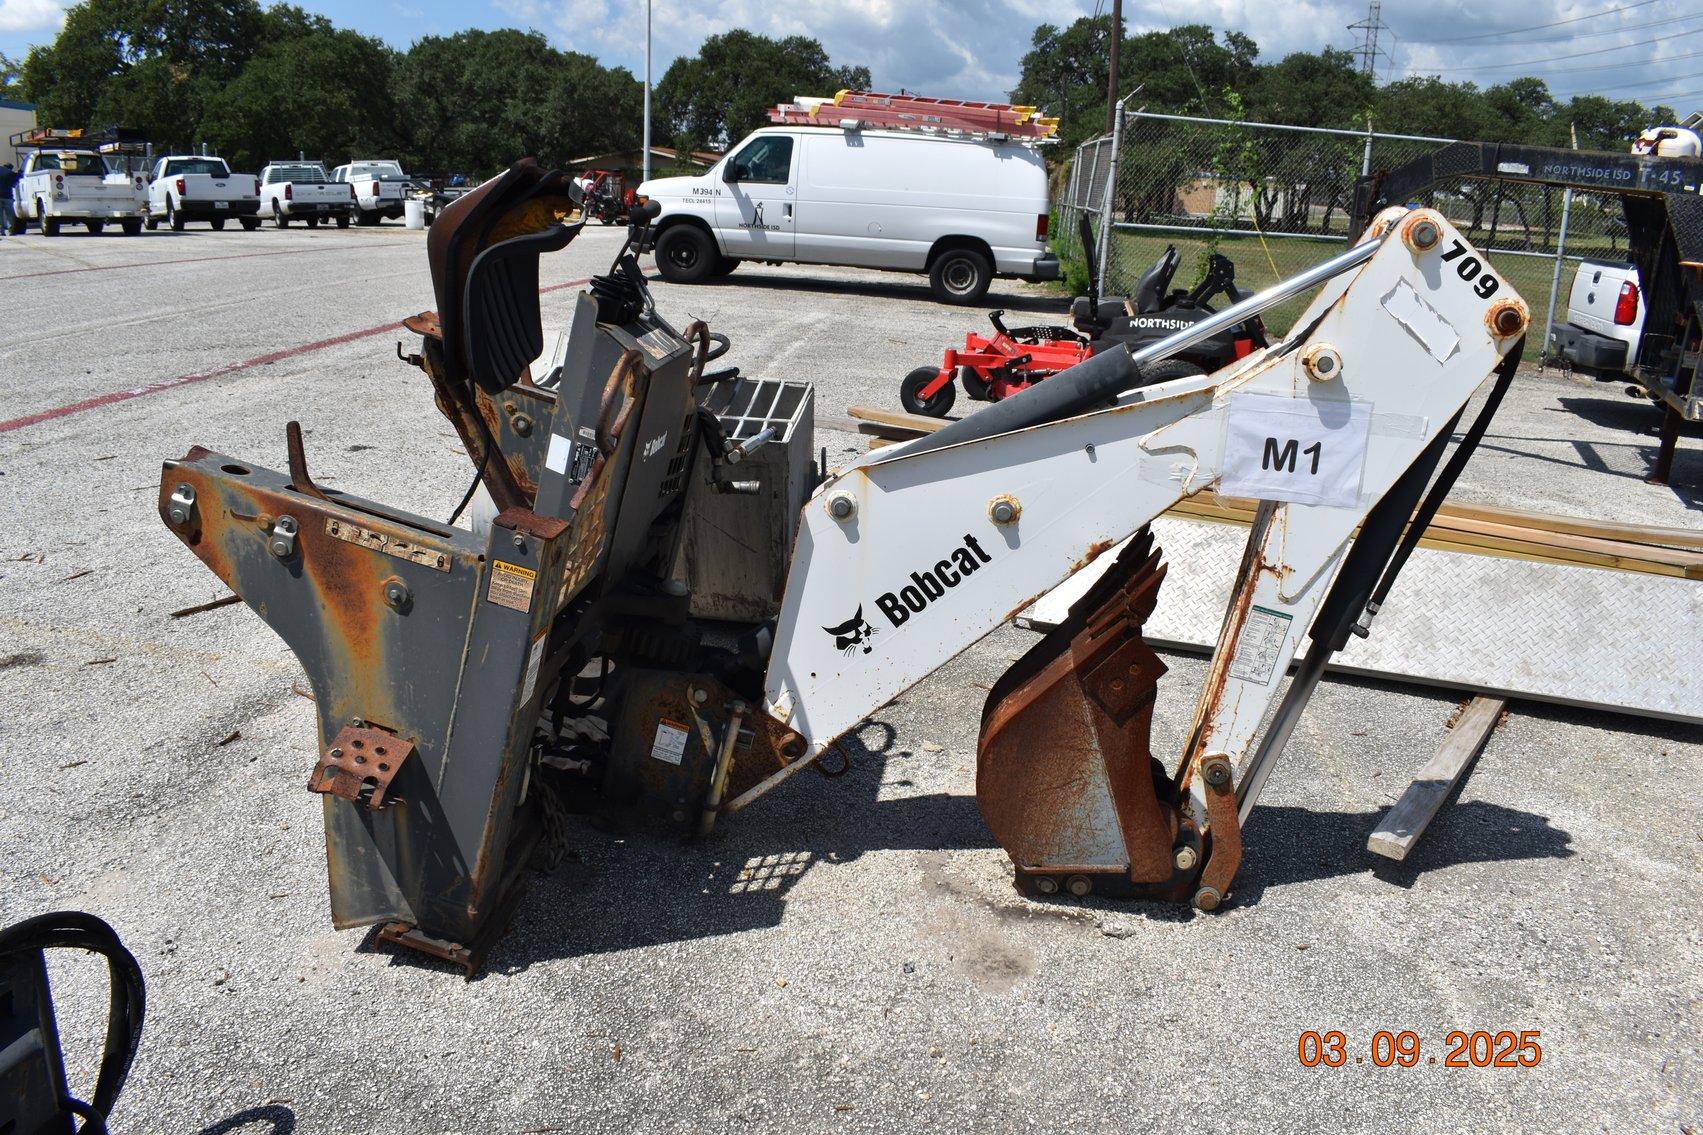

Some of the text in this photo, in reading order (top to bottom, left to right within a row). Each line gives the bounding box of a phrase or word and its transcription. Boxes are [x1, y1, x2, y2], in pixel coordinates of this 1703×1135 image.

[1543, 166, 1631, 180] NORTHSIDE ISD
[1639, 168, 1682, 185] T-45
[1440, 238, 1499, 299] 709
[1262, 437, 1322, 475] M1
[503, 564, 534, 578] WARNING
[875, 533, 992, 629] Bobcat
